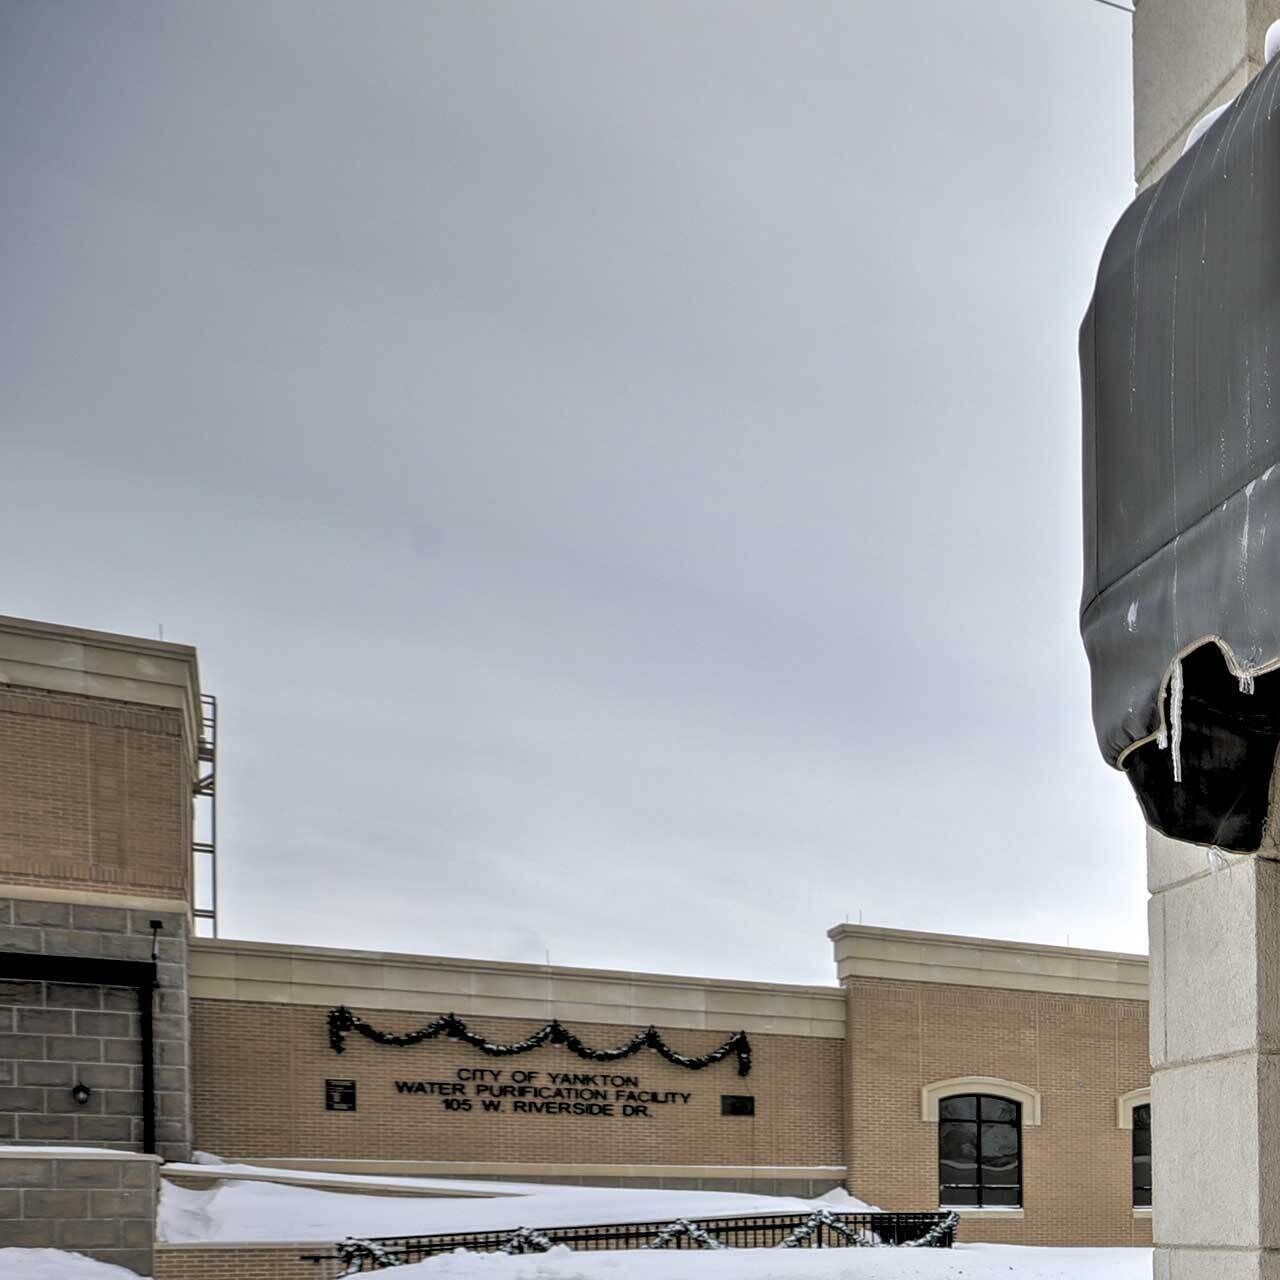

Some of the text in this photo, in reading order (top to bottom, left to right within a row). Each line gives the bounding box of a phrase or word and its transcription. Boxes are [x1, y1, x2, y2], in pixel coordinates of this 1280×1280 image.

[457, 1068, 638, 1087] CITY OF YANKTON
[395, 1081, 691, 1104] WATER PURIFICATION FACILITY
[442, 1099, 653, 1117] 105 W. RIVERSIDE DR.
